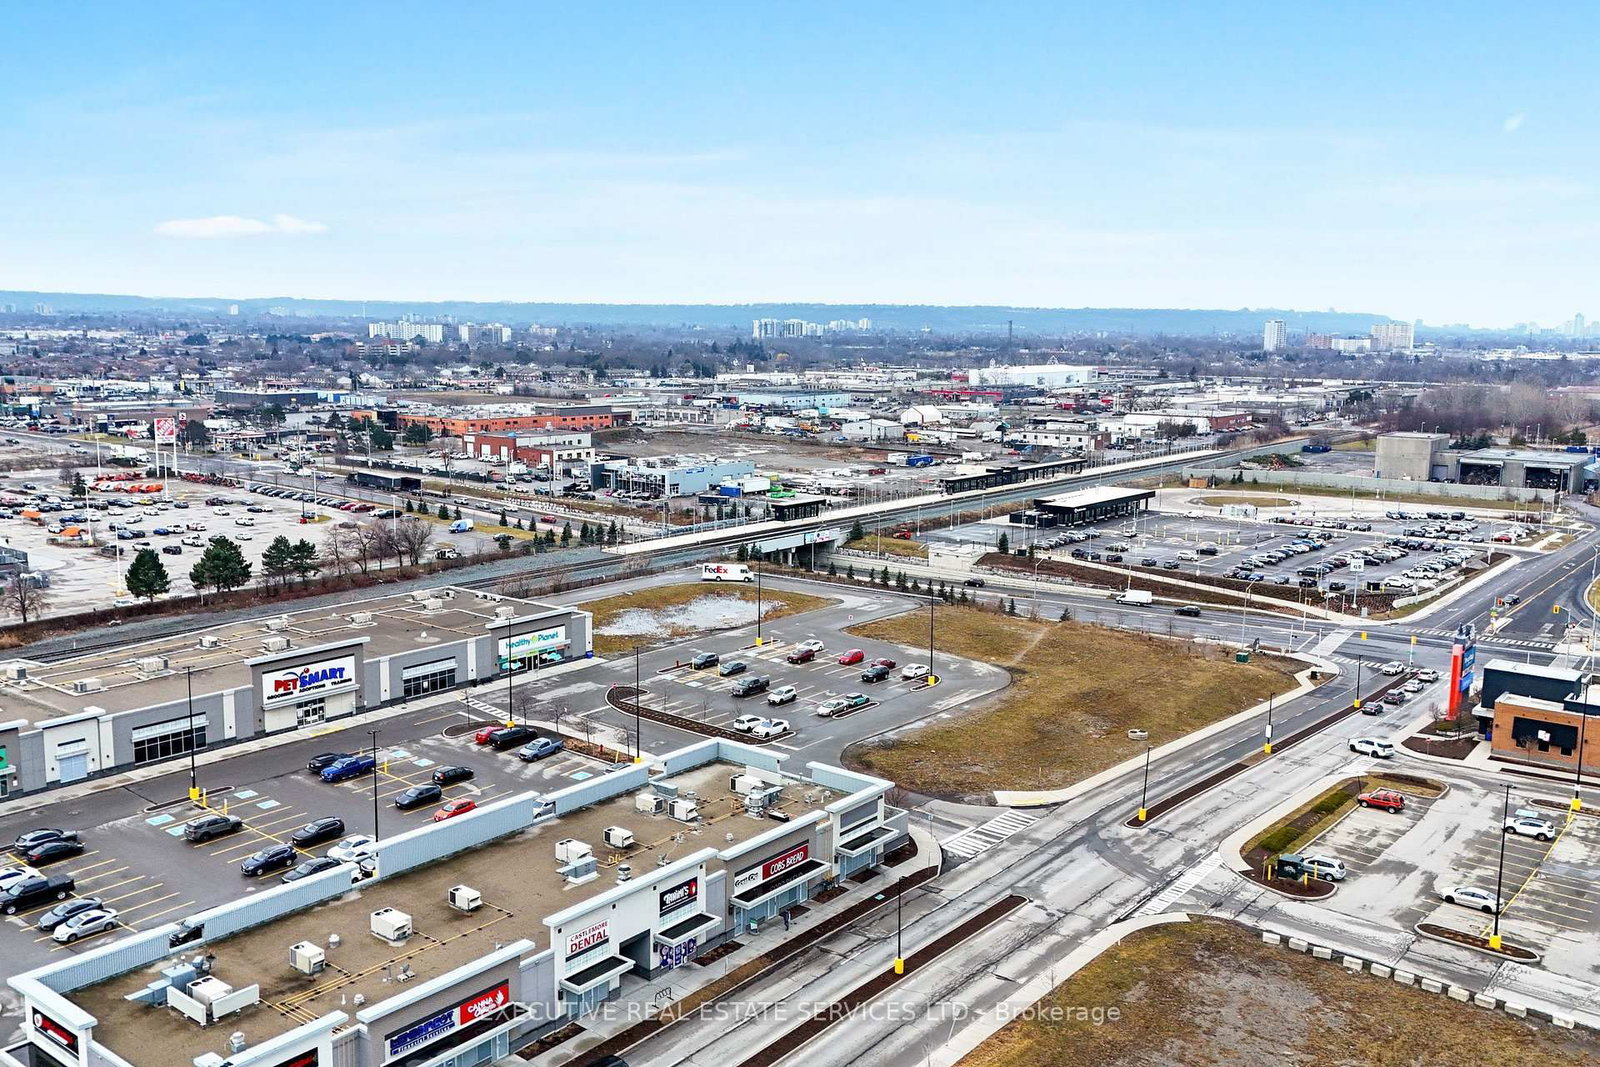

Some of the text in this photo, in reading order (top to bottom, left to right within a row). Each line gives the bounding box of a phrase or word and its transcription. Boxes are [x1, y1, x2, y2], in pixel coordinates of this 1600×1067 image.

[704, 565, 729, 574] FedEx
[505, 630, 559, 649] Healthy Planet
[770, 851, 804, 875] COBS BREAD
[570, 920, 608, 942] CASTLEMORE
[570, 928, 609, 953] DENTAL
[467, 996, 494, 1014] CANNA
